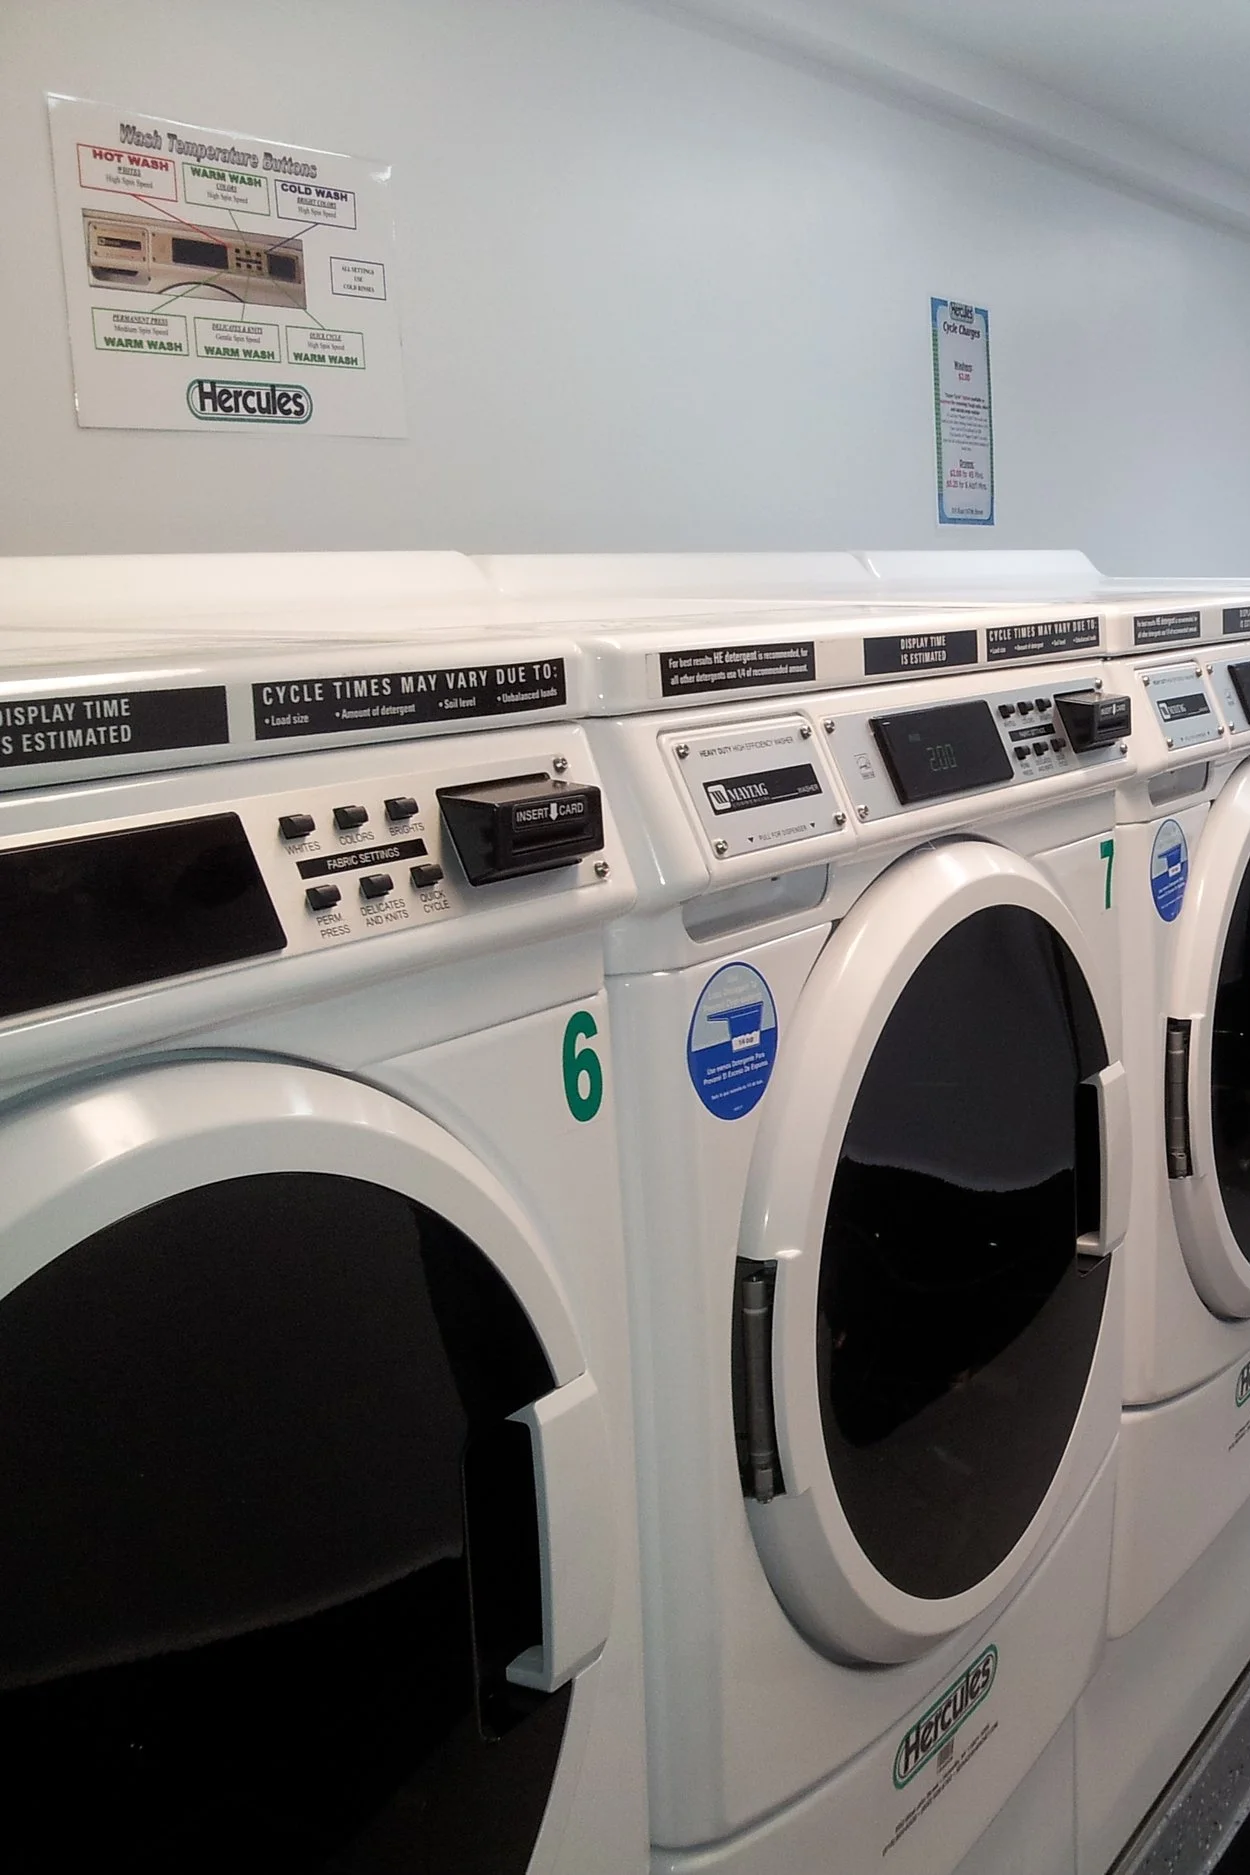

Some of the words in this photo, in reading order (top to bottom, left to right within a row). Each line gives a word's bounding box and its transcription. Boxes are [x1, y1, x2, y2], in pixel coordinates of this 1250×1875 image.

[92, 149, 125, 163] HOT
[128, 155, 169, 171] WASH
[120, 123, 162, 150] Wash
[167, 133, 259, 168] Temperature
[263, 152, 318, 179] Buttons
[191, 166, 227, 181] WARM
[229, 173, 262, 187] WASH
[281, 183, 312, 196] COLD
[315, 189, 348, 202] WASH
[943, 321, 958, 335] Cycle
[958, 325, 981, 340] Charges
[104, 336, 144, 349] WARM
[147, 340, 183, 353] WASH
[204, 345, 240, 358] WARM
[242, 349, 275, 361] WASH
[293, 352, 326, 363] WARM
[328, 355, 358, 366] WASH
[198, 381, 305, 416] Hercules
[989, 629, 1012, 642] CYCLE
[1014, 626, 1036, 639] TIMES
[1038, 624, 1052, 636] MAY
[1054, 622, 1071, 634] VARY
[1072, 620, 1085, 632] DUE
[900, 636, 928, 650] DISPLAY
[929, 635, 946, 647] TIME
[668, 658, 679, 669] For
[679, 656, 692, 668] best
[693, 655, 713, 666] results
[713, 652, 723, 664] HE
[724, 650, 757, 664] detergent
[757, 650, 763, 660] is
[901, 654, 909, 665] IS
[909, 650, 947, 665] ESTIMATED
[670, 674, 679, 685] all
[680, 673, 695, 684] other
[696, 671, 726, 683] detergents
[726, 670, 737, 679] use
[737, 668, 746, 678] 1/4
[746, 667, 752, 677] of
[752, 664, 788, 676] recommended
[262, 683, 324, 705] CYCLE
[333, 678, 392, 699] TIMES
[401, 674, 437, 694] MAY
[446, 669, 487, 690] VARY
[496, 666, 526, 685] DUE
[533, 663, 557, 681] TO:
[444, 697, 458, 709] Soil
[459, 696, 476, 707] level
[502, 690, 540, 703] Unbalanced
[541, 687, 558, 698] loads
[0, 702, 75, 727] ISPLAY
[83, 698, 131, 720] TIME
[271, 713, 291, 726] Load
[293, 713, 309, 724] size
[342, 708, 371, 720] Amount
[372, 705, 380, 716] of
[380, 702, 416, 717] detergent
[0, 735, 13, 755] S
[22, 724, 132, 752] ESTIMATED
[700, 748, 718, 757] HEAVY
[719, 746, 732, 755] DUTY
[745, 740, 774, 751] EFFICIENCY
[727, 783, 769, 801] MAYTAG
[797, 783, 819, 793] WASHER
[516, 807, 549, 822] INSERT
[559, 802, 584, 816] CARD
[339, 831, 375, 846] COLORS
[389, 822, 425, 837] BRIGHTS
[284, 841, 321, 855] WHITES
[327, 854, 358, 870] FABRIC
[360, 847, 400, 863] SETTINGS
[1100, 839, 1114, 910] 7
[420, 890, 446, 903] QUICK
[360, 899, 405, 917] DELICATES
[423, 900, 450, 913] CYCLE
[366, 915, 384, 927] AND
[385, 909, 409, 923] KNITS
[320, 925, 351, 938] PRESS
[562, 1010, 603, 1122] 6
[902, 1657, 991, 1774] Hercules
